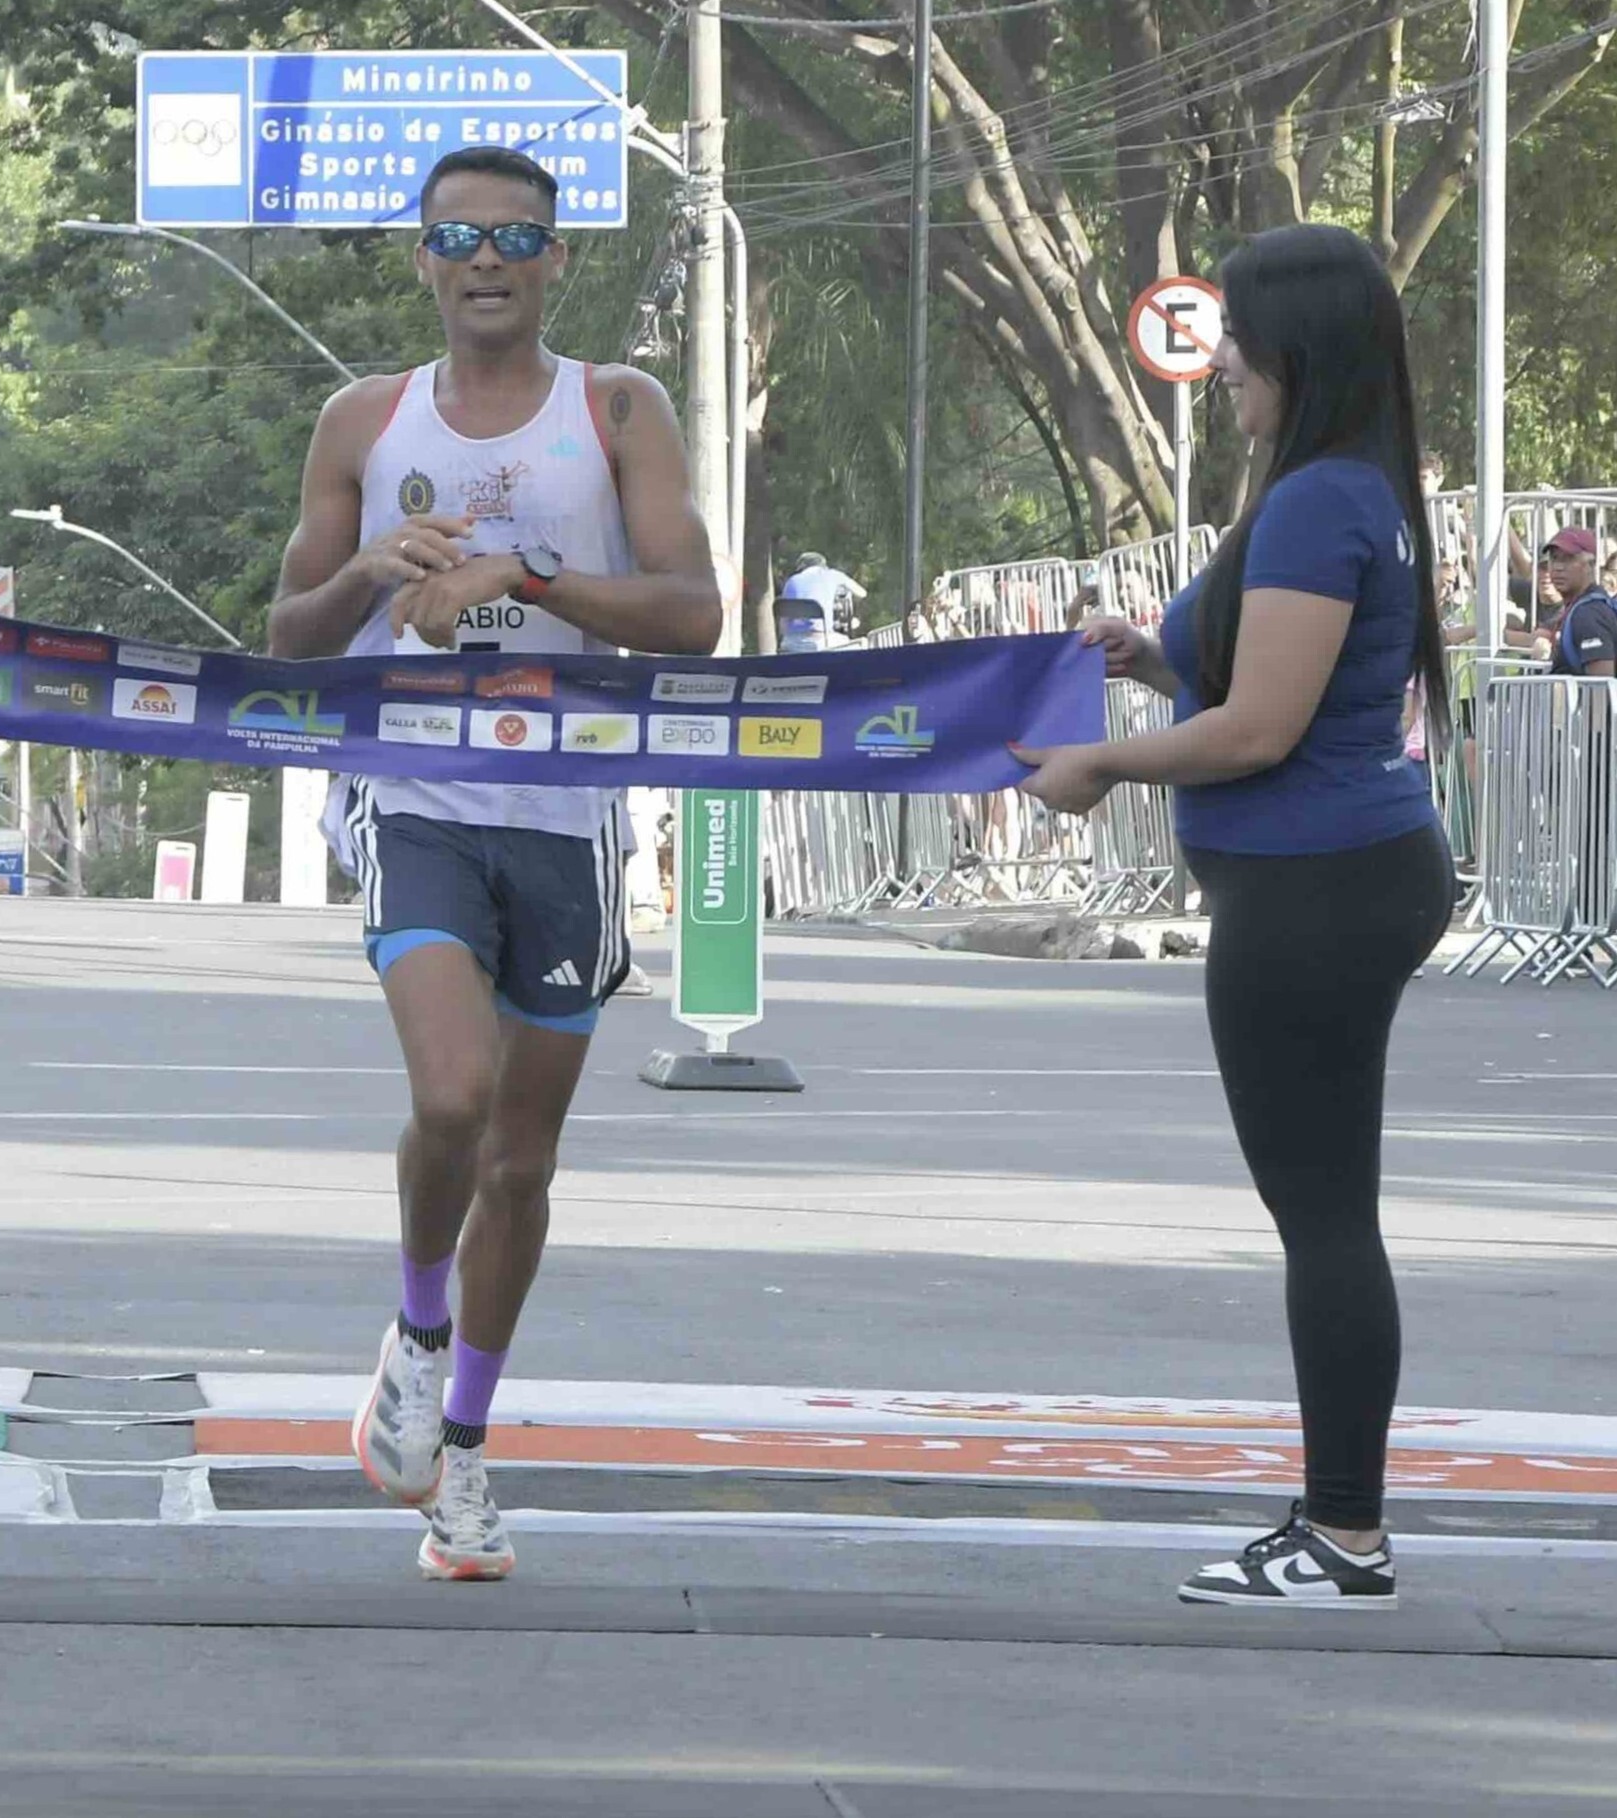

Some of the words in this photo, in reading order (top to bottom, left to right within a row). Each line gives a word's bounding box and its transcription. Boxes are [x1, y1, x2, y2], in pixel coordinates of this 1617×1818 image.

[342, 62, 533, 93] Mineirinho
[260, 111, 385, 143] Ginásio
[405, 117, 441, 143] de
[461, 116, 618, 149] Esportes
[298, 151, 418, 179] Sports
[260, 185, 408, 211] Gimnasio
[1166, 303, 1197, 353] E
[455, 606, 526, 629] ABIO
[33, 684, 70, 696] smart
[758, 724, 802, 746] BALY
[703, 798, 725, 908] Unimed
